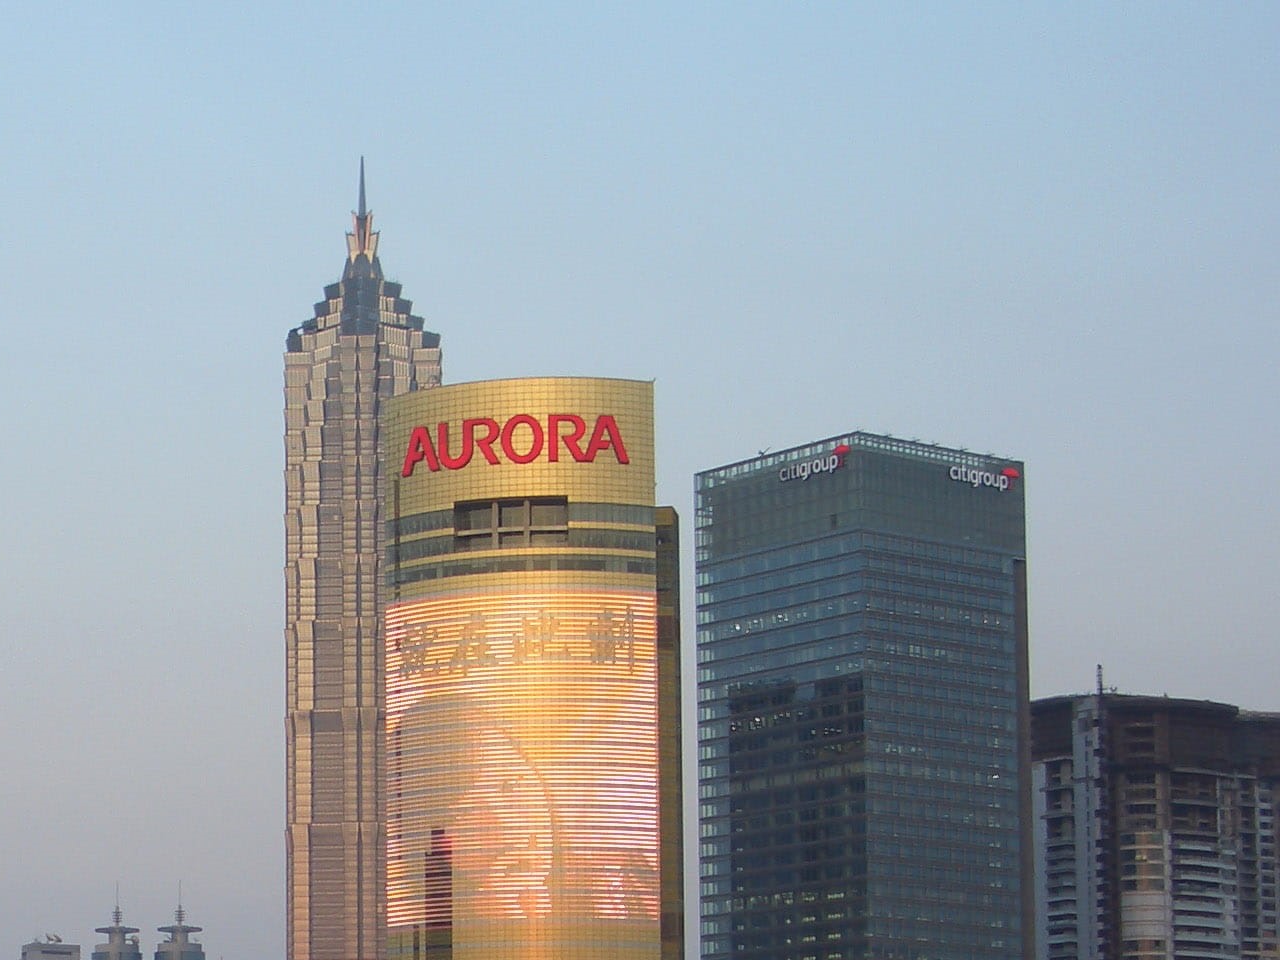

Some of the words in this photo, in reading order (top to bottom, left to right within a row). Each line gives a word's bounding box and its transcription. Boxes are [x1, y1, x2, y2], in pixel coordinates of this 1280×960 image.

[402, 413, 630, 478] AURORA
[779, 453, 839, 482] citigroup
[949, 464, 1009, 491] citigroup
